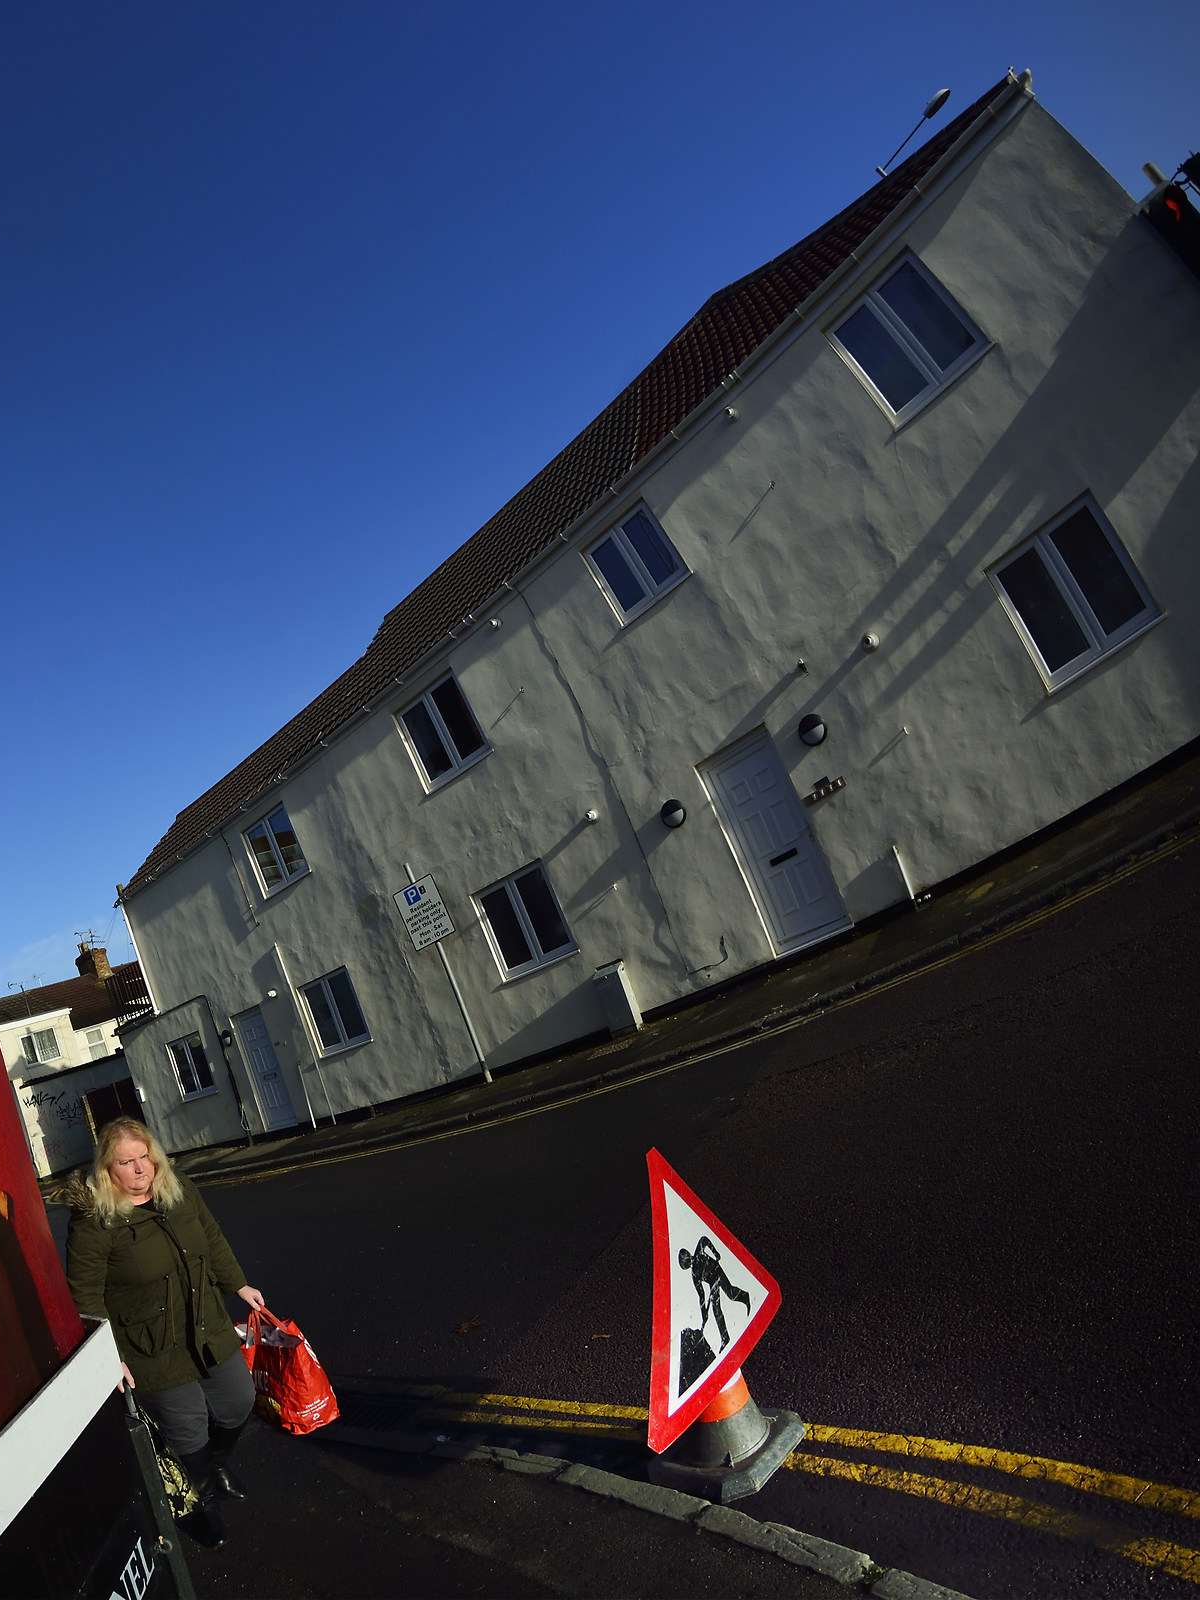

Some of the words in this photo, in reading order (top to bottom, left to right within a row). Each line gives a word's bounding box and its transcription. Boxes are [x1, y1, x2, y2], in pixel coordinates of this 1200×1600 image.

[405, 910, 422, 923] permit
[421, 900, 442, 913] holders
[409, 898, 432, 913] Resident
[410, 914, 429, 928] parking
[429, 908, 441, 917] only
[410, 925, 422, 935] past
[421, 919, 432, 928] this
[432, 911, 447, 923] point
[433, 922, 444, 930] Sat
